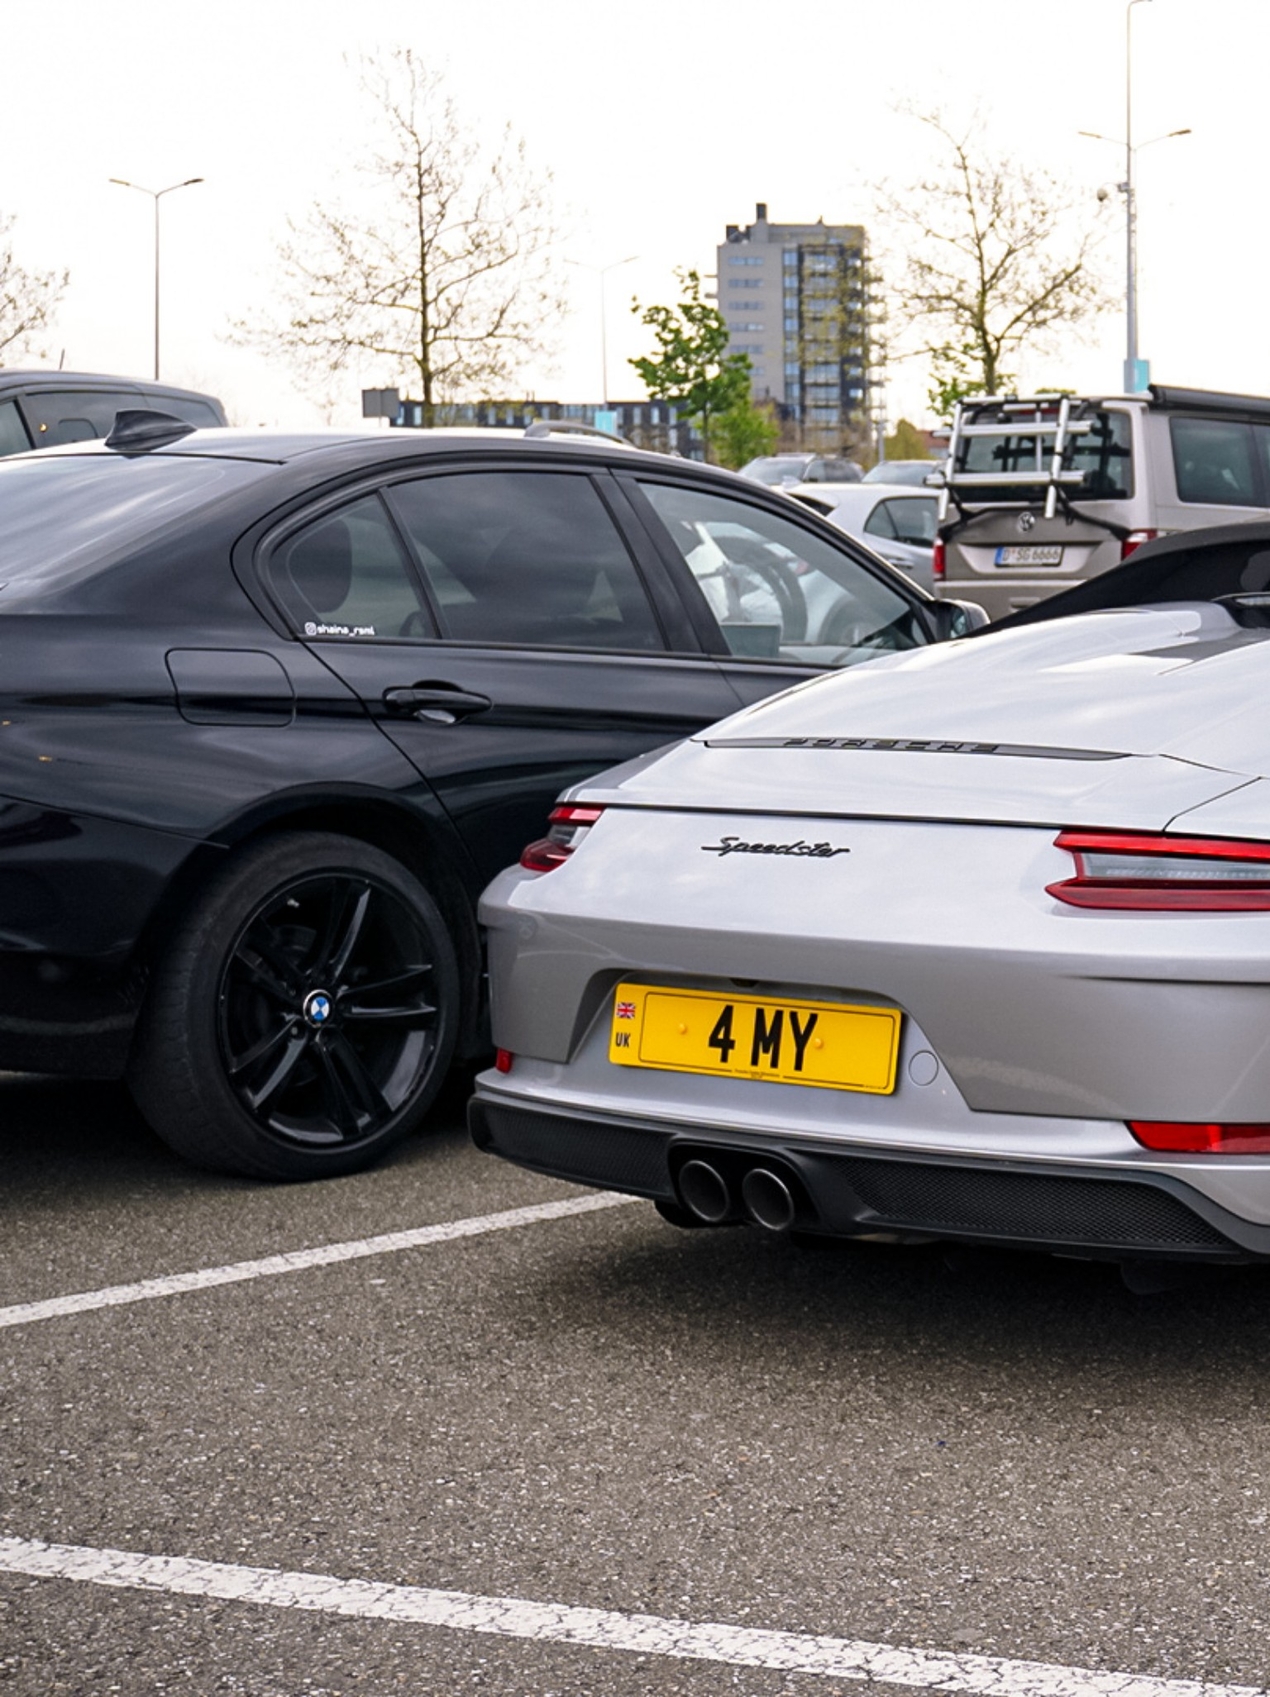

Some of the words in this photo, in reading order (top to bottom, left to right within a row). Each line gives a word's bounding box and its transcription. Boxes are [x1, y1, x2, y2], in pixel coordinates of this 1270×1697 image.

[783, 737, 999, 753] PORSCHE
[701, 837, 850, 857] Speedster
[615, 1033, 631, 1047] UK
[708, 1005, 735, 1063] 4
[750, 1007, 818, 1072] MY
